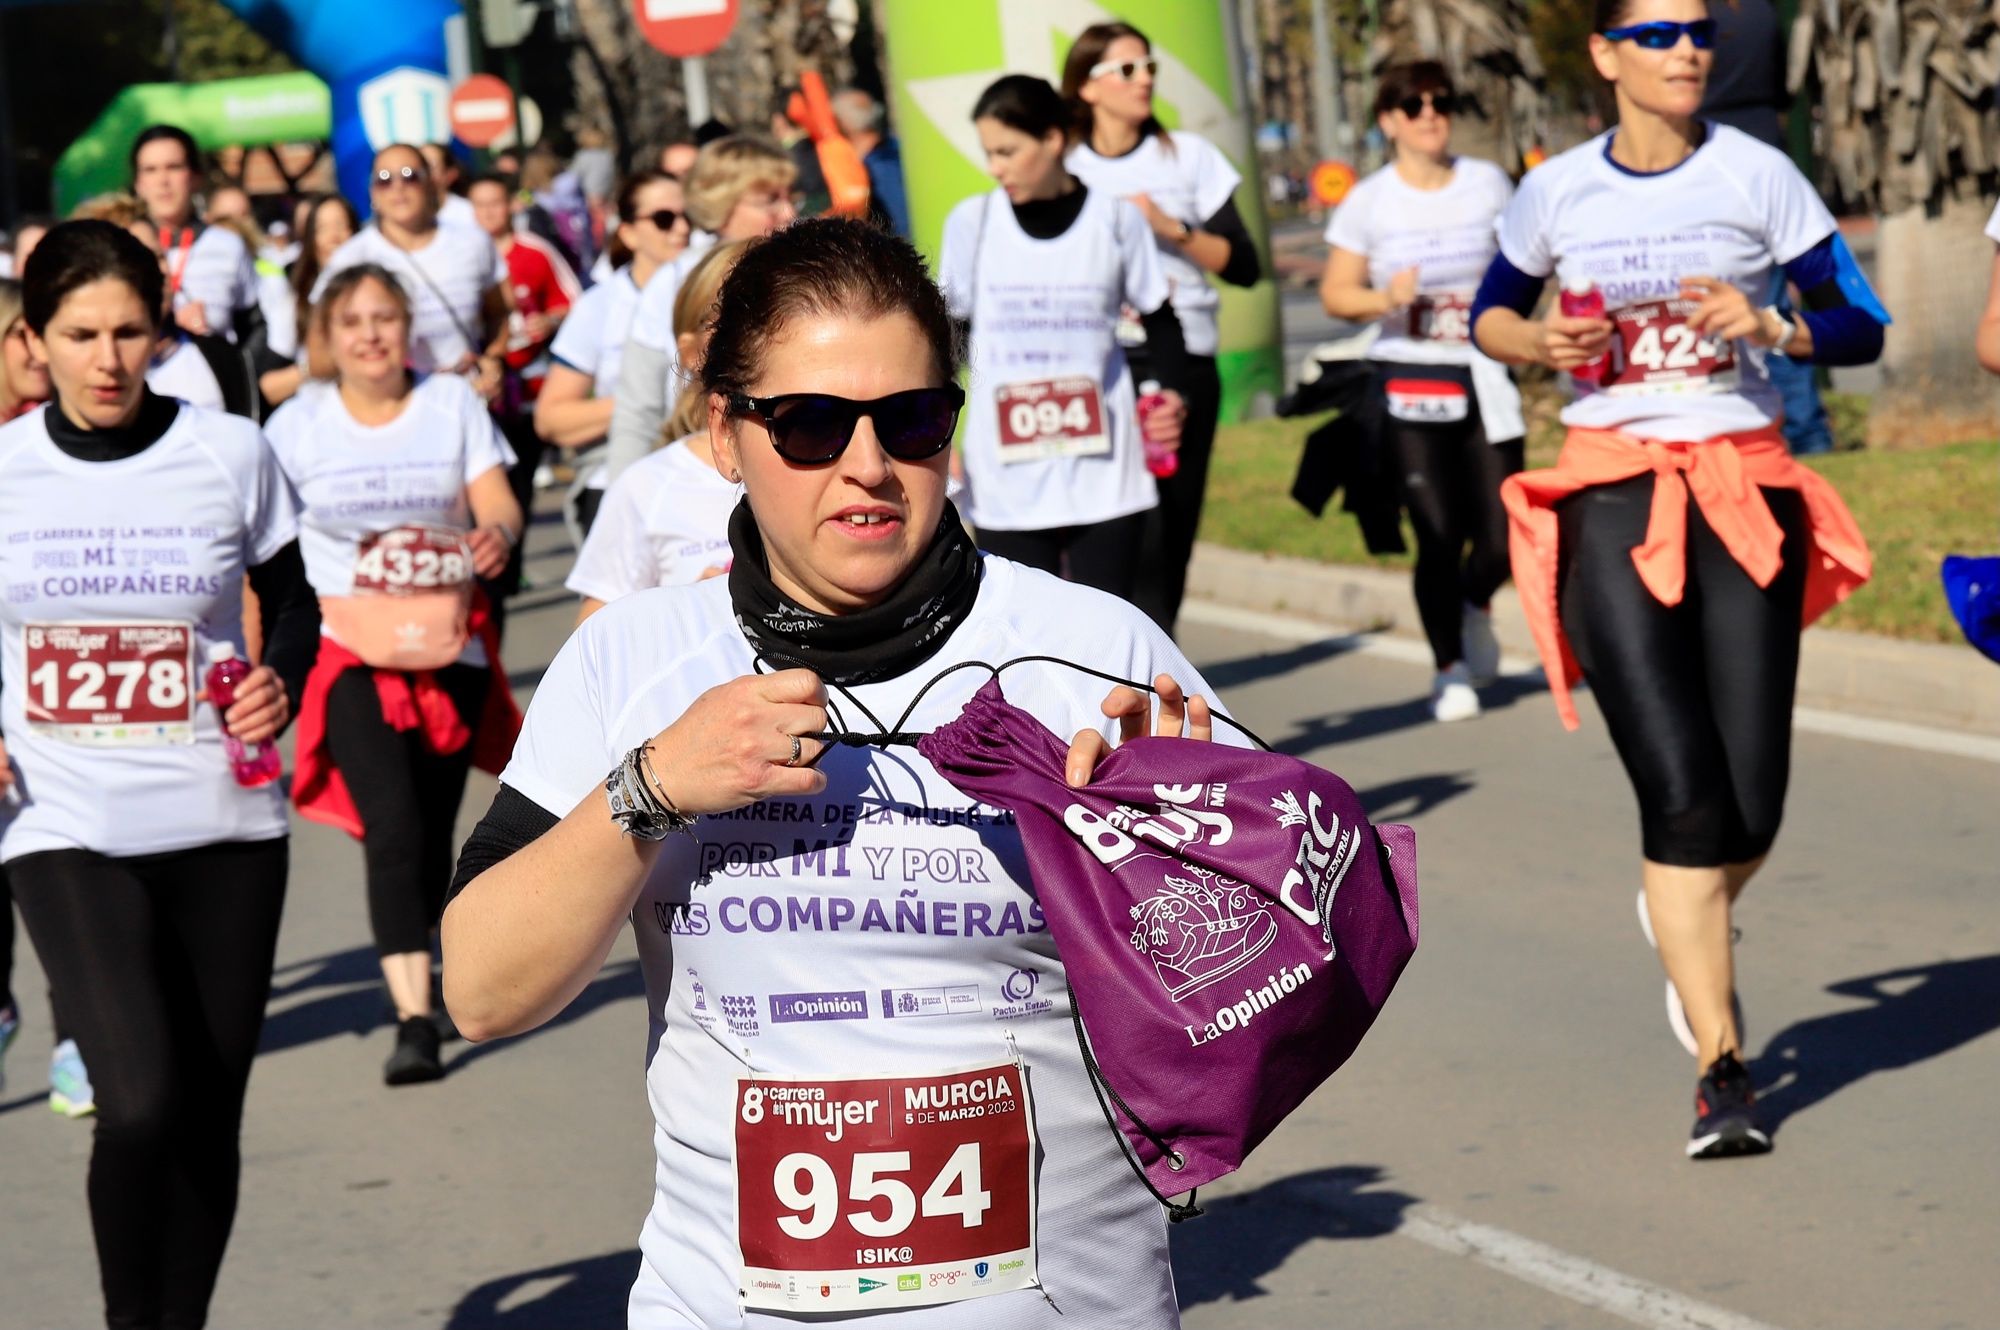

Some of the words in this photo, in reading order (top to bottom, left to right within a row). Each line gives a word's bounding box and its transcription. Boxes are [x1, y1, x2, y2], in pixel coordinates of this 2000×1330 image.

[1009, 396, 1092, 438] 094
[34, 526, 94, 541] CARRERA
[99, 526, 116, 540] DE
[120, 526, 137, 539] LA
[141, 526, 185, 539] MUJER
[83, 539, 115, 567] MÍ
[43, 569, 222, 598] COMPAÑERAS
[356, 547, 466, 588] 4328
[30, 660, 187, 710] 1278
[823, 803, 857, 824] DE
[863, 806, 894, 826] LA
[903, 806, 983, 827] MUJER
[700, 841, 780, 878] POR
[791, 827, 851, 877] MÍ
[863, 846, 894, 881] Y
[903, 846, 990, 884] POR
[1279, 790, 1340, 927] CRC
[1324, 829, 1351, 882] CENTRAL
[655, 902, 710, 936] MIS
[718, 889, 1048, 938] COMPAÑERAS
[993, 1006, 1017, 1016] Pacto
[1025, 998, 1054, 1011] Estado
[1184, 962, 1313, 1048] LaOpinión
[769, 1087, 825, 1101] carrera
[905, 1075, 1012, 1110] MURCIA
[785, 1099, 879, 1142] mujer
[905, 1113, 914, 1125] 5
[918, 1112, 935, 1124] DE
[939, 1106, 985, 1122] MARZO
[988, 1099, 1016, 1115] 2023
[773, 1142, 992, 1240] 954
[856, 1246, 914, 1265] ISIK@
[899, 1279, 919, 1289] CRC
